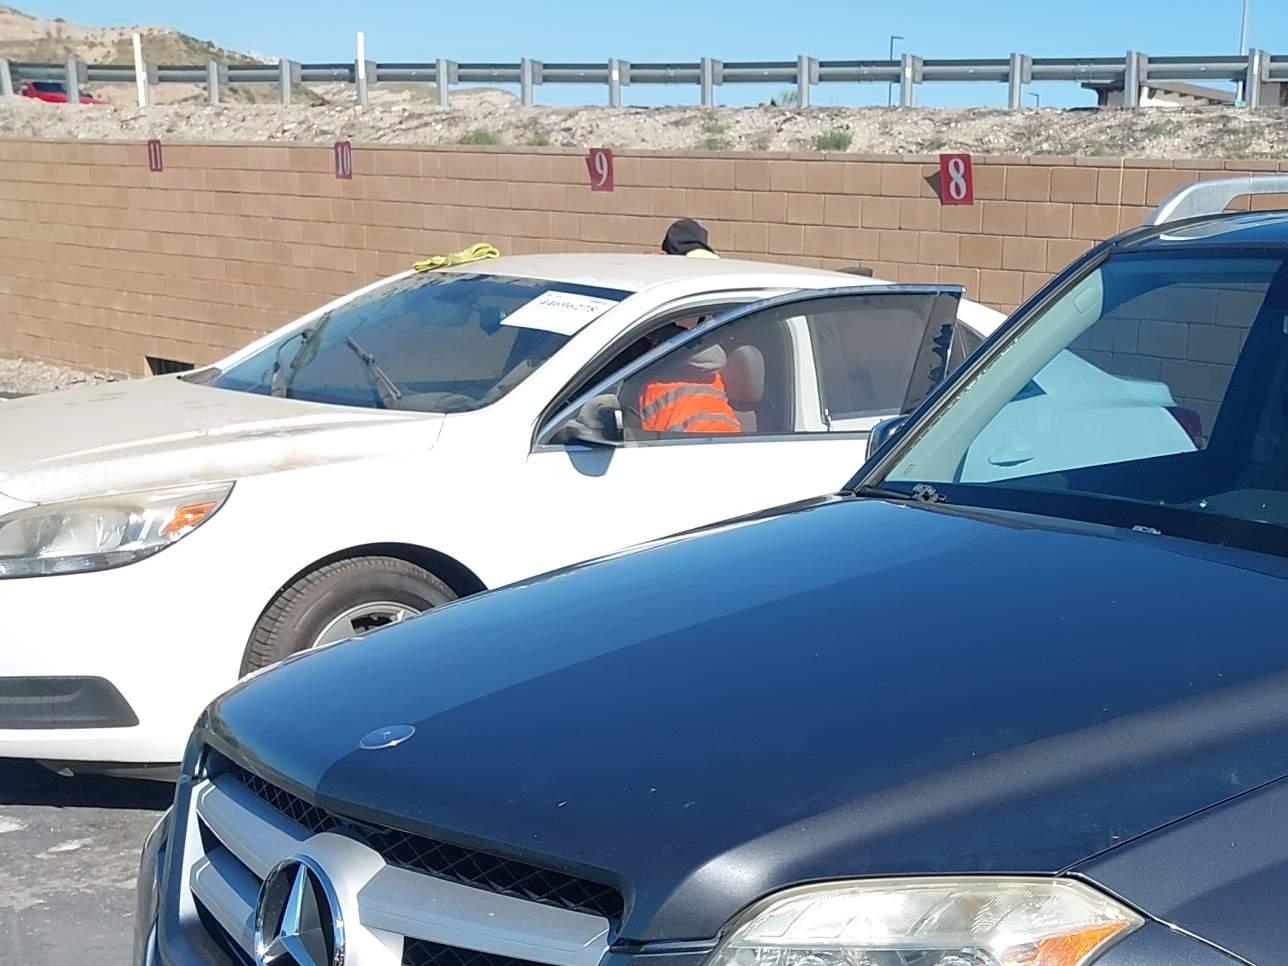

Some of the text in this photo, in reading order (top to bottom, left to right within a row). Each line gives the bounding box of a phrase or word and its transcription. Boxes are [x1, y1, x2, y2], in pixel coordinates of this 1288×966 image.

[150, 142, 161, 169] 11
[337, 144, 351, 176] 10
[594, 151, 609, 186] 9
[948, 158, 967, 200] 8
